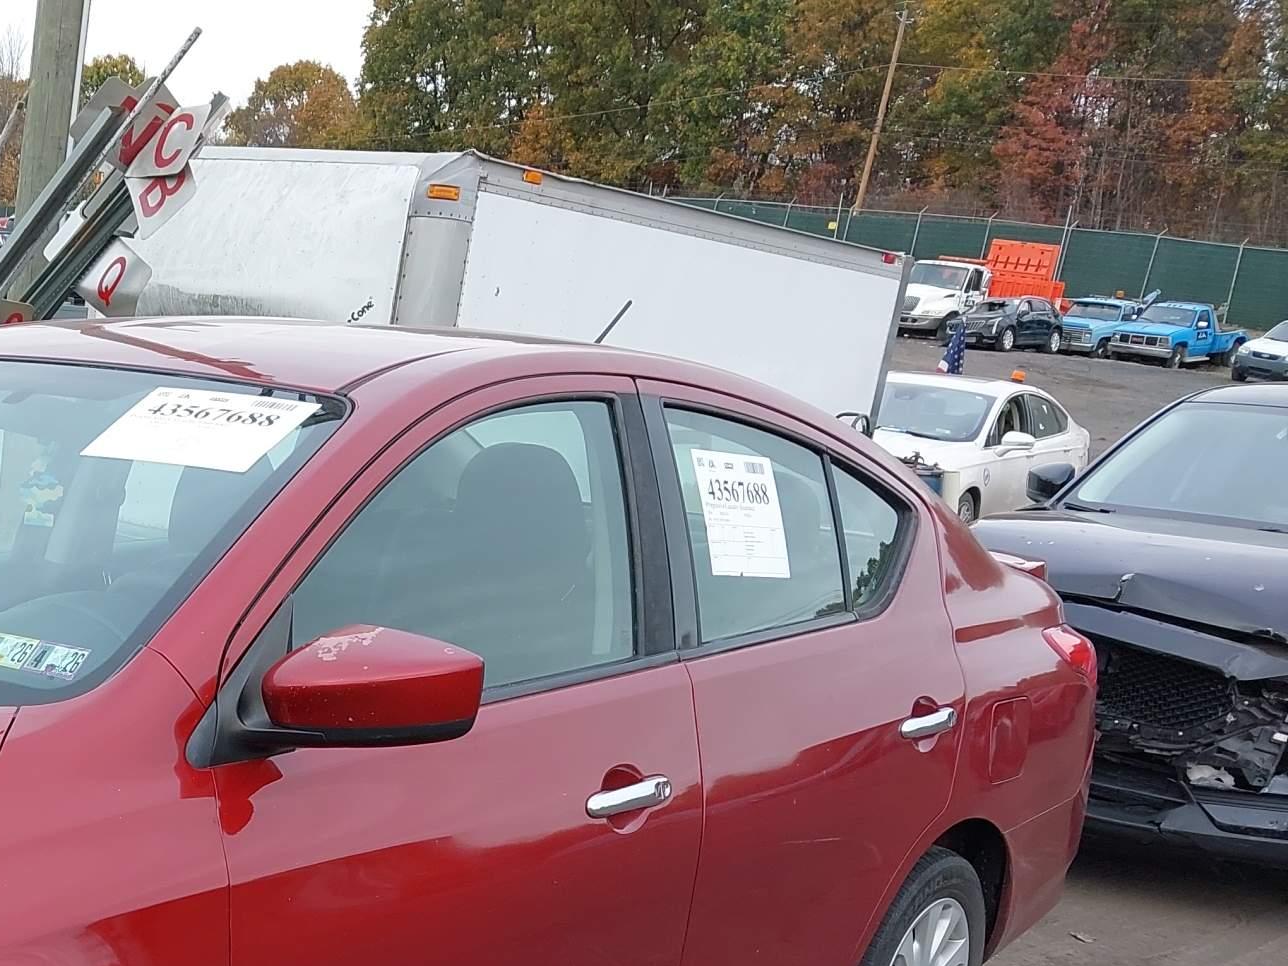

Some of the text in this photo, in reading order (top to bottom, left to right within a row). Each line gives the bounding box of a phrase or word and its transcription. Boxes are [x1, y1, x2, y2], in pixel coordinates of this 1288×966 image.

[98, 256, 127, 307] Q
[147, 402, 281, 428] 43567688
[708, 478, 770, 505] 43567688
[10, 642, 35, 664] 26
[61, 651, 86, 674] 26
